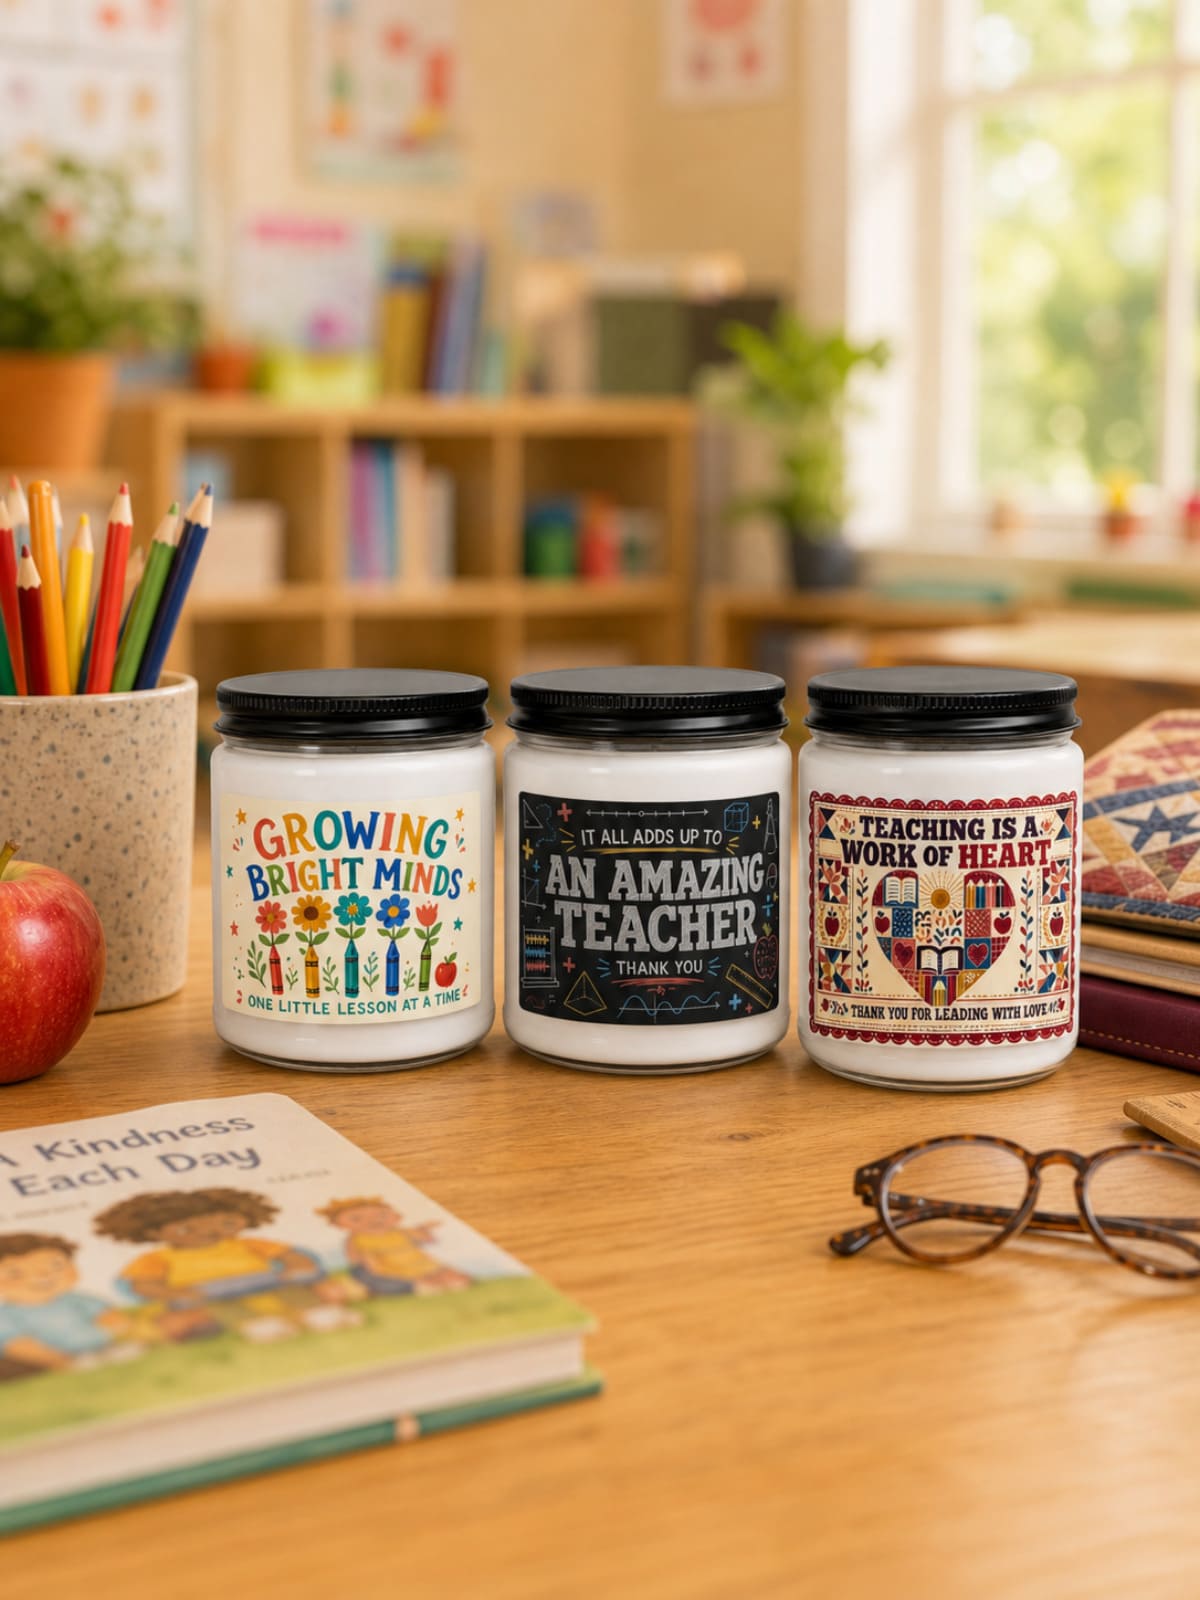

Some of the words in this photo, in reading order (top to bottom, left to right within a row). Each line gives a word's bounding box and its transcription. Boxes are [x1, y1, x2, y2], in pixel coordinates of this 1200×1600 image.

[253, 810, 449, 860] GROWING
[581, 829, 595, 846] IT
[600, 829, 628, 845] ALL
[632, 829, 674, 845] ADDS
[680, 829, 700, 845] UP
[703, 829, 722, 846] TO
[860, 816, 985, 840] TEACHING
[991, 816, 1017, 840] IS
[840, 839, 918, 869] WORK
[923, 845, 954, 867] OF
[958, 839, 1052, 869] HEART
[246, 857, 364, 901] BRIGHT
[372, 858, 463, 900] MINDS
[545, 854, 597, 899] AN
[608, 852, 765, 901] AMAZING
[554, 899, 758, 953] TEACHER
[616, 960, 669, 976] THANK
[674, 959, 704, 975] YOU
[247, 994, 273, 1011] ONE
[278, 999, 330, 1015] LITTLE
[337, 1000, 397, 1016] LESSON
[402, 997, 419, 1012] AT
[422, 993, 432, 1008] A
[434, 988, 461, 1006] TIME
[851, 1004, 886, 1020] THANK
[888, 1006, 909, 1020] YOU
[911, 1007, 932, 1021] FOR
[935, 1007, 989, 1021] LEADING
[992, 1006, 1021, 1021] WITH
[1024, 1002, 1047, 1019] LOVE
[34, 1115, 255, 1161] Kindness
[10, 1162, 140, 1197] Each
[158, 1144, 262, 1174] Day
